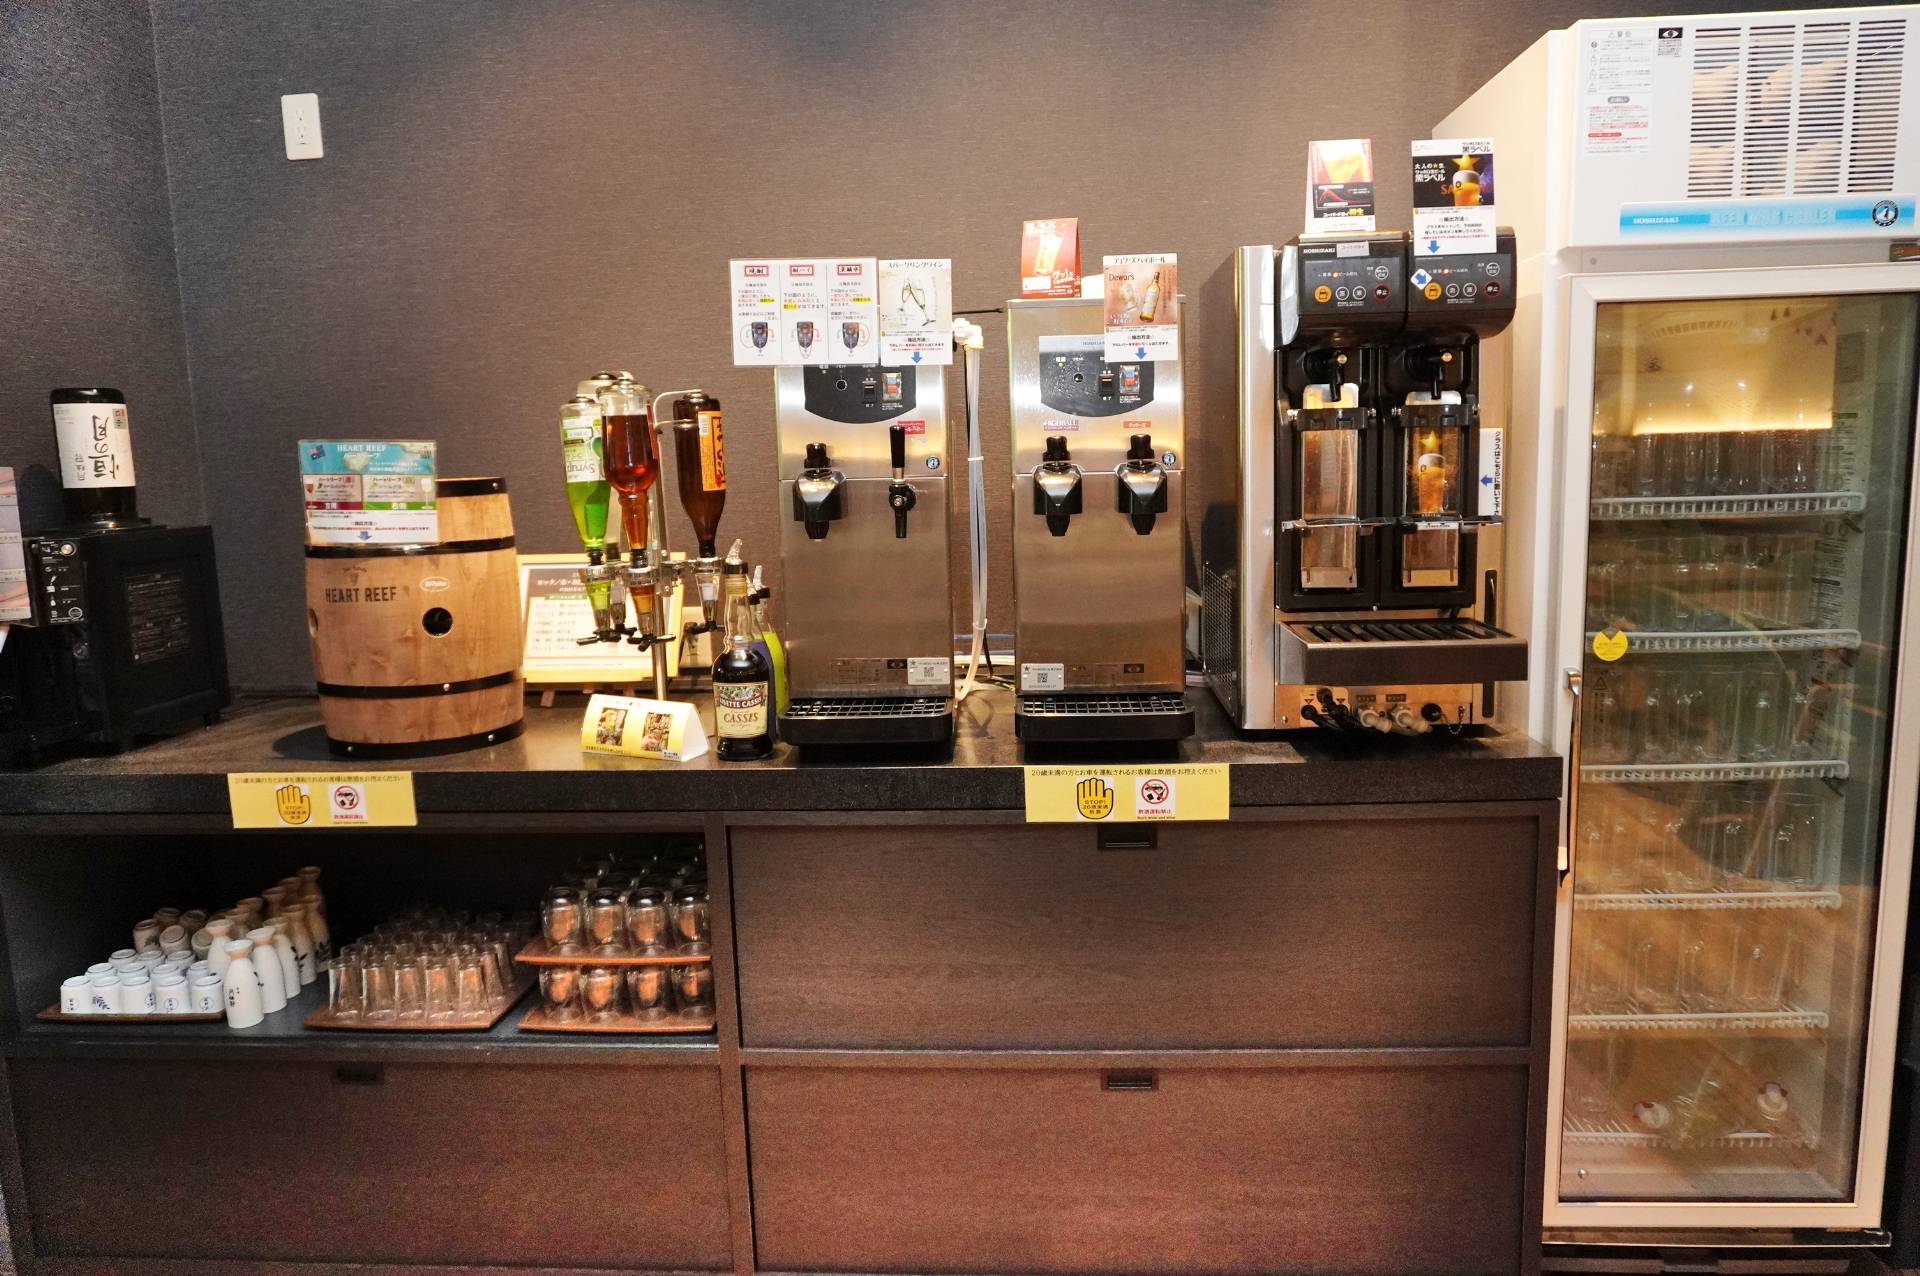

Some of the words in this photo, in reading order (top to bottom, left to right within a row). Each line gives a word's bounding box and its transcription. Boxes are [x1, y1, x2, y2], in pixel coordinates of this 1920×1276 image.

[1415, 173, 1446, 182] 黒ラベル
[1711, 210, 1746, 227] BEER
[1747, 208, 1781, 226] MUG
[1784, 207, 1836, 225] COOLER
[1026, 221, 1056, 229] BLACK
[1114, 256, 1166, 264] デュワーズハイボール
[1376, 288, 1388, 296] 停止
[337, 444, 364, 452] HEART
[366, 444, 387, 452] REEF
[567, 461, 595, 474] Syrup
[325, 588, 359, 603] HEART
[364, 586, 397, 602] REEF
[723, 712, 759, 723] CASSIS
[1031, 768, 1221, 776] 20歳未満の方とお車を運転されるお客様は飲酒をお控えください
